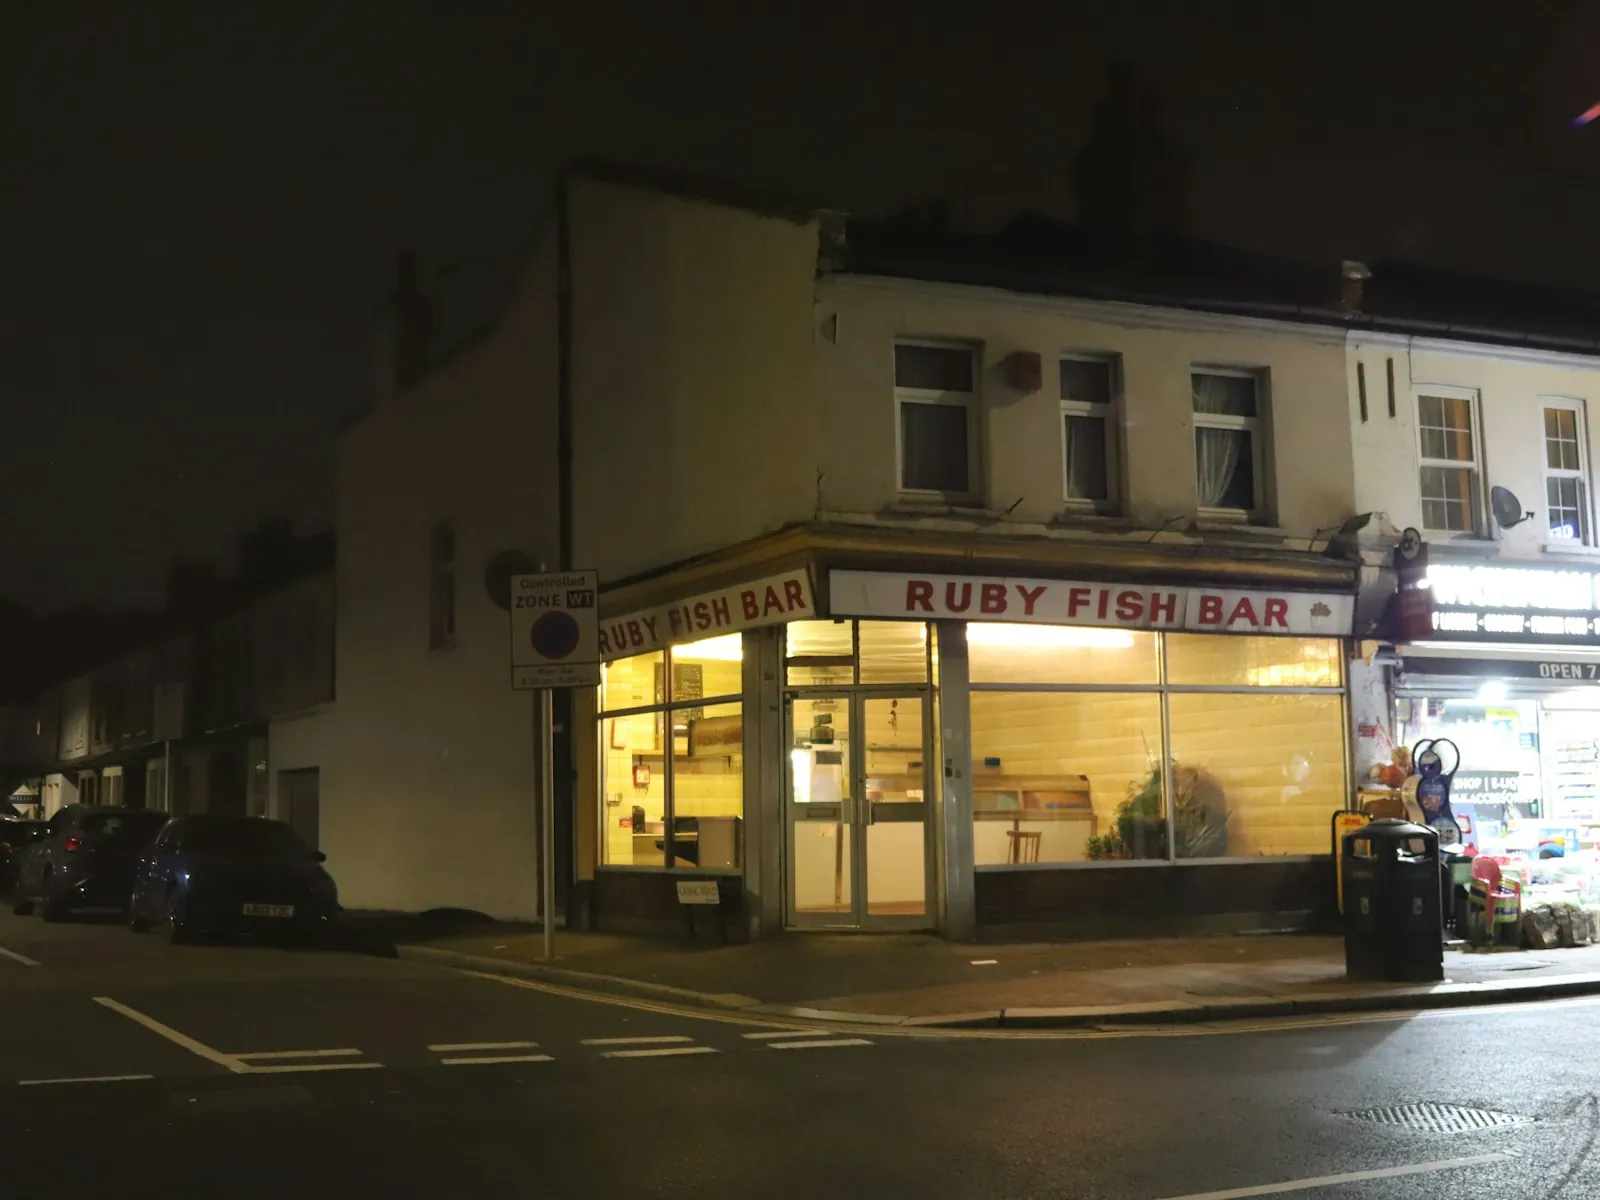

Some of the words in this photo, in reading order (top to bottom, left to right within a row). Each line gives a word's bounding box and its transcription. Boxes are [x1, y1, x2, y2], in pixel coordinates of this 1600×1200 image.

[520, 576, 585, 589] Controlled
[515, 594, 561, 608] ZONE
[569, 592, 593, 606] WT
[906, 580, 1046, 615] RUBY
[1068, 588, 1175, 622] FISH
[1198, 595, 1289, 627] BAR
[600, 615, 657, 655] RUBY
[668, 596, 731, 636] FISH
[740, 579, 806, 620] BAR
[1539, 663, 1582, 679] OPEN
[1587, 664, 1597, 679] 7
